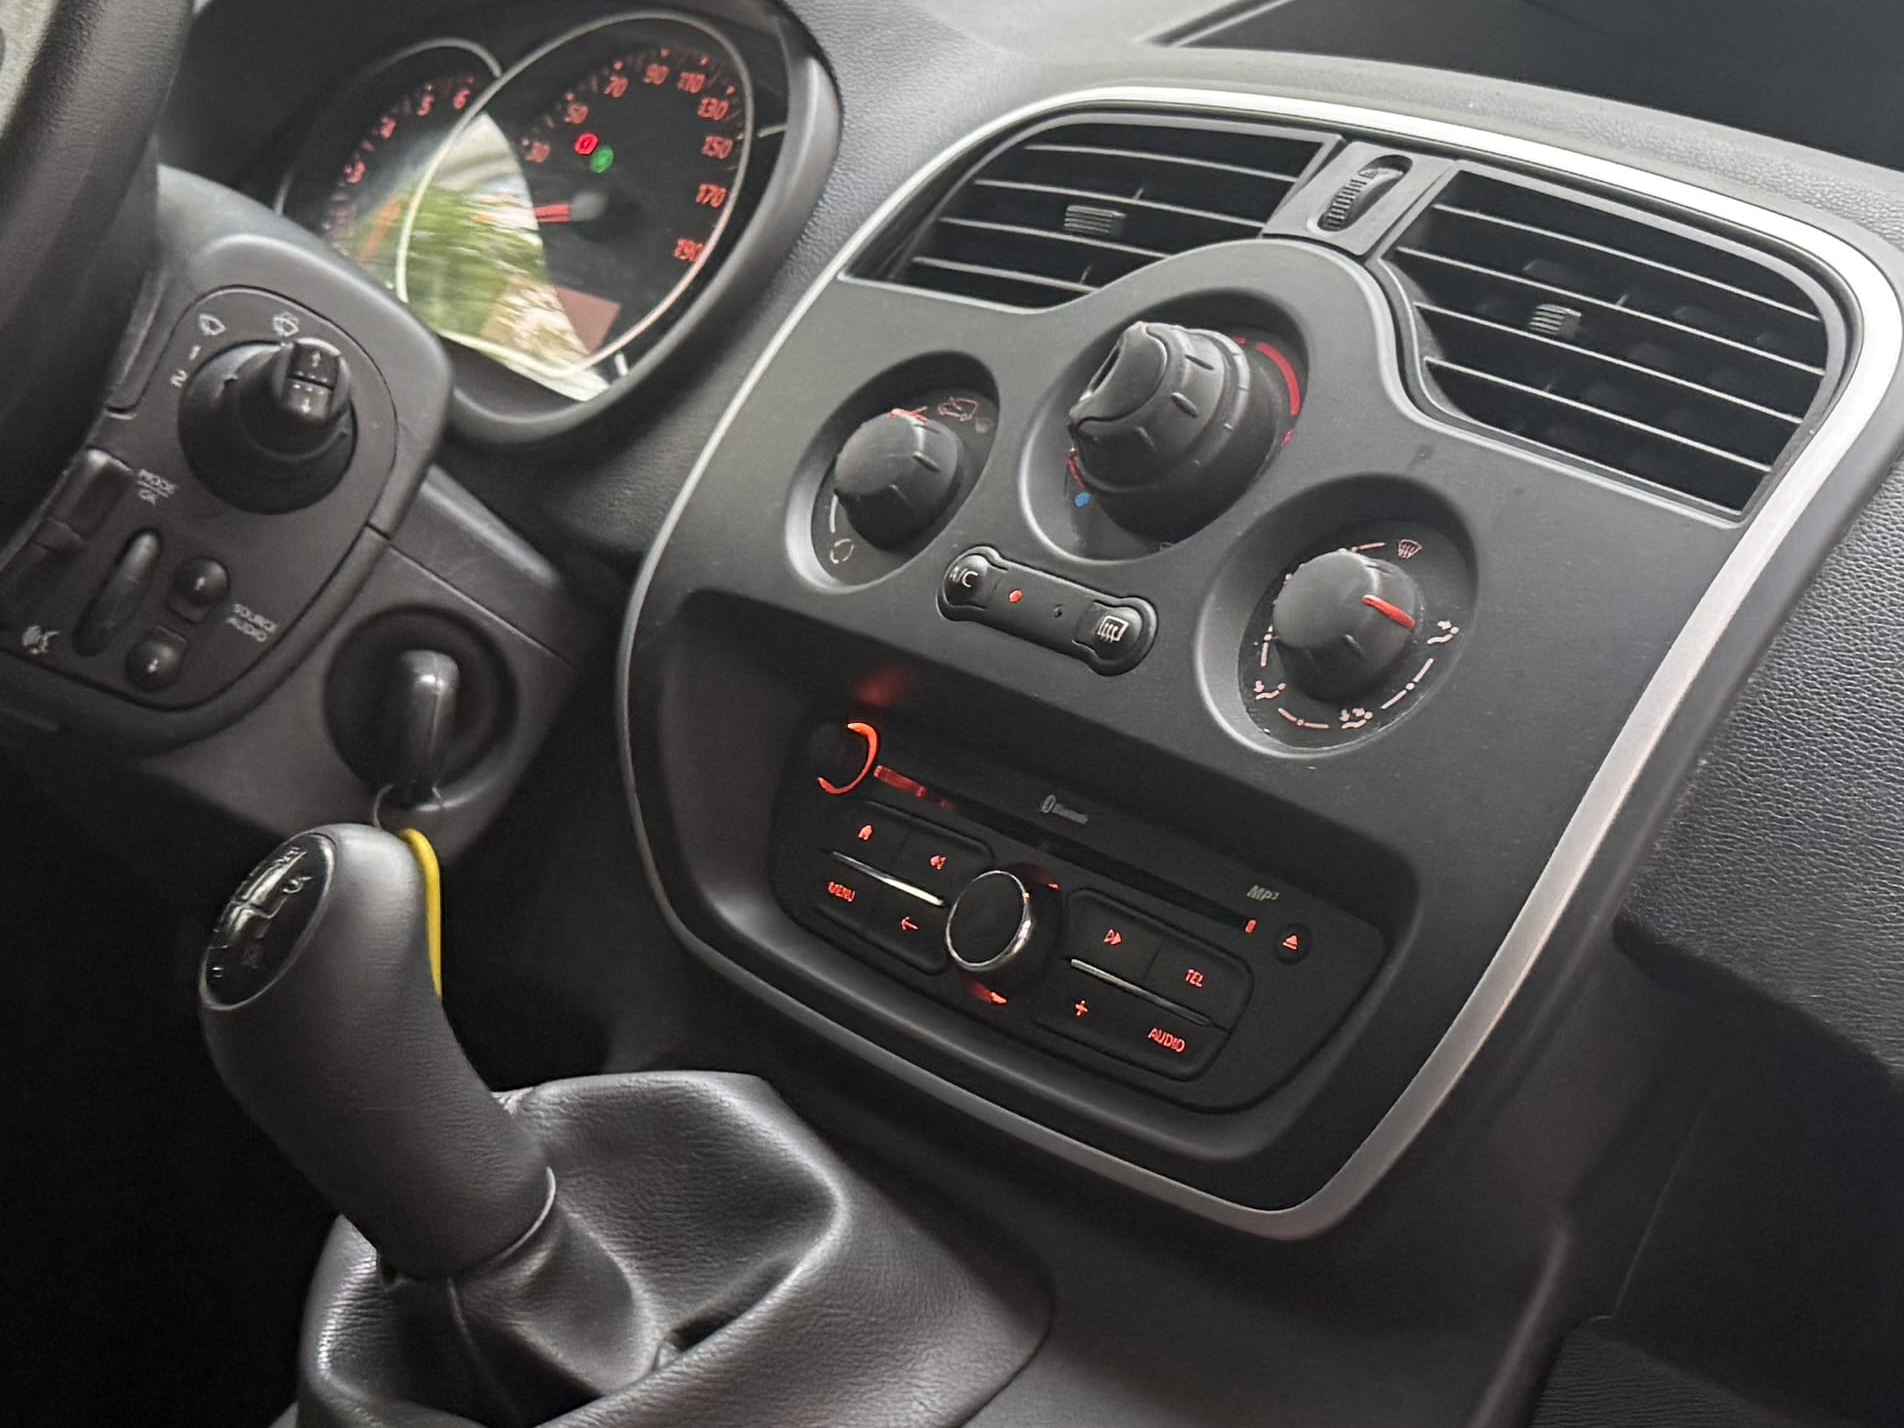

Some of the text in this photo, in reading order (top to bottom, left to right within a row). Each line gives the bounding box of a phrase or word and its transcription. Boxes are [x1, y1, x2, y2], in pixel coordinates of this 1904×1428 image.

[697, 96, 730, 121] 130
[701, 134, 734, 160] 150
[696, 182, 728, 208] 170
[827, 880, 857, 903] MENU
[1184, 967, 1205, 989] TEL
[1147, 1026, 1187, 1053] AUDIO
